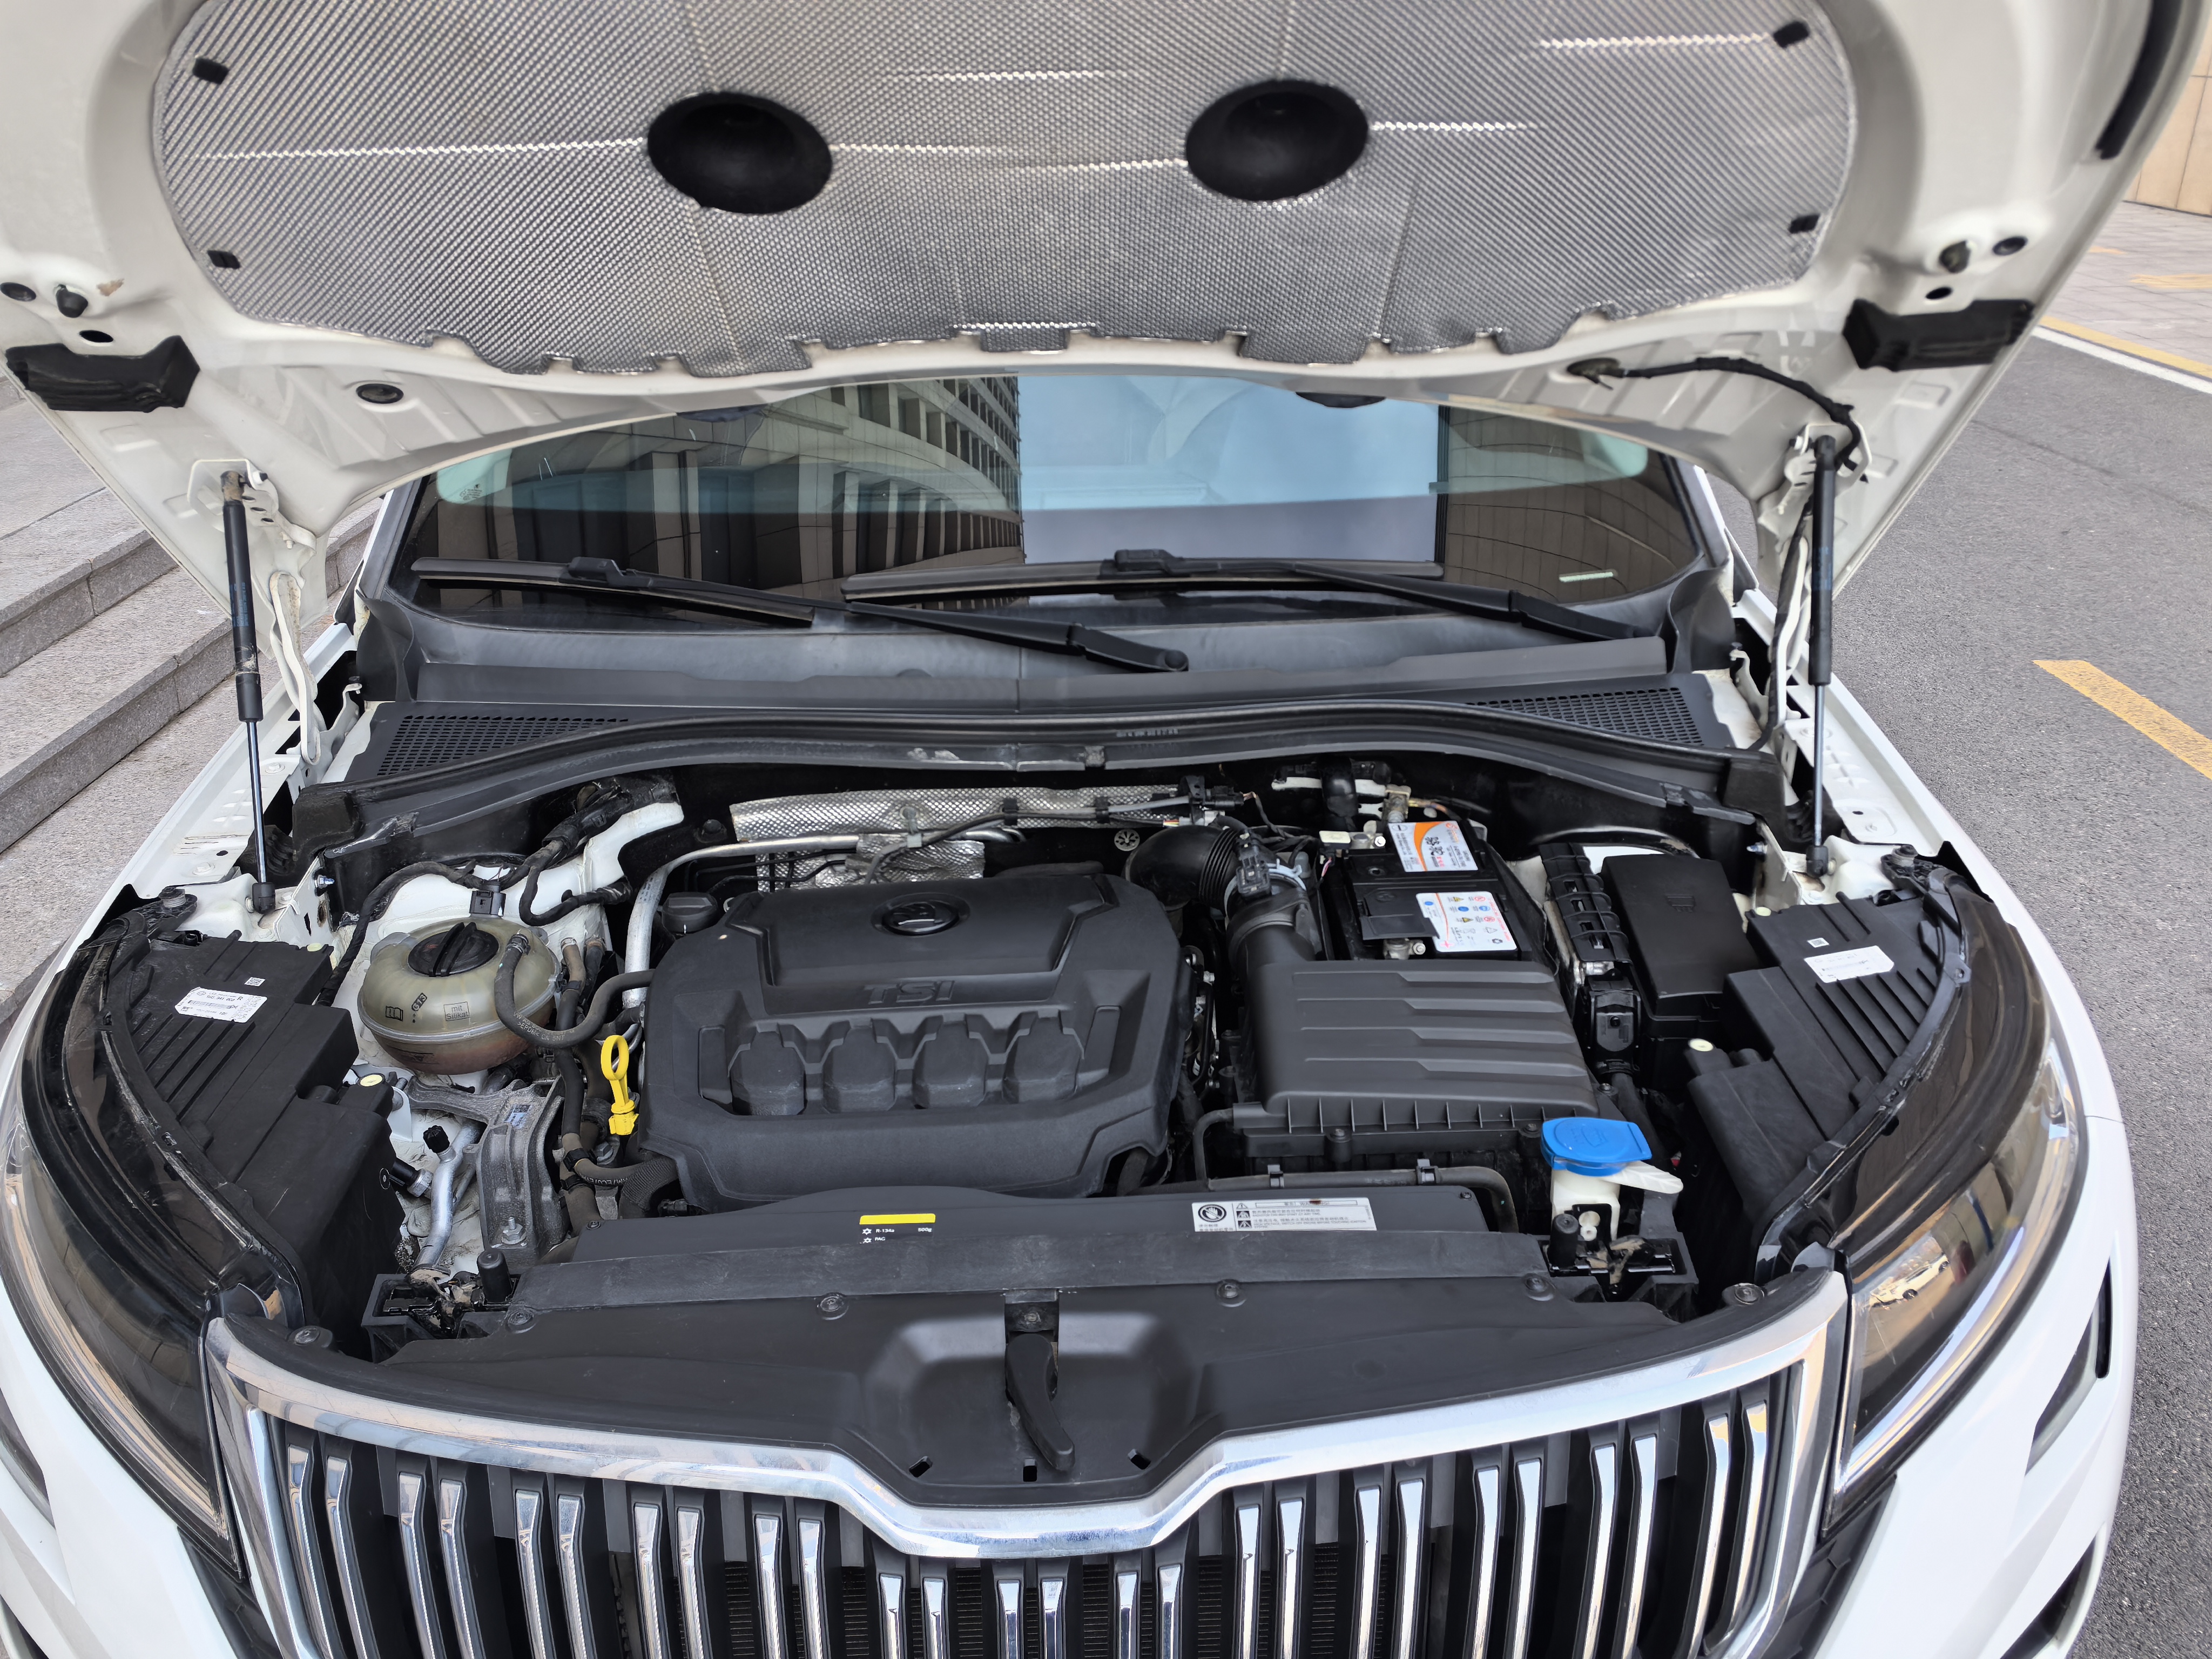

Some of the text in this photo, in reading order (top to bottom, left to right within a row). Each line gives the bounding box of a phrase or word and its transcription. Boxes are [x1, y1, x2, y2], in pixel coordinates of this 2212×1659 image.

[863, 980, 955, 1004] TSI
[412, 994, 427, 1011] G13
[446, 1011, 469, 1020] Silikat
